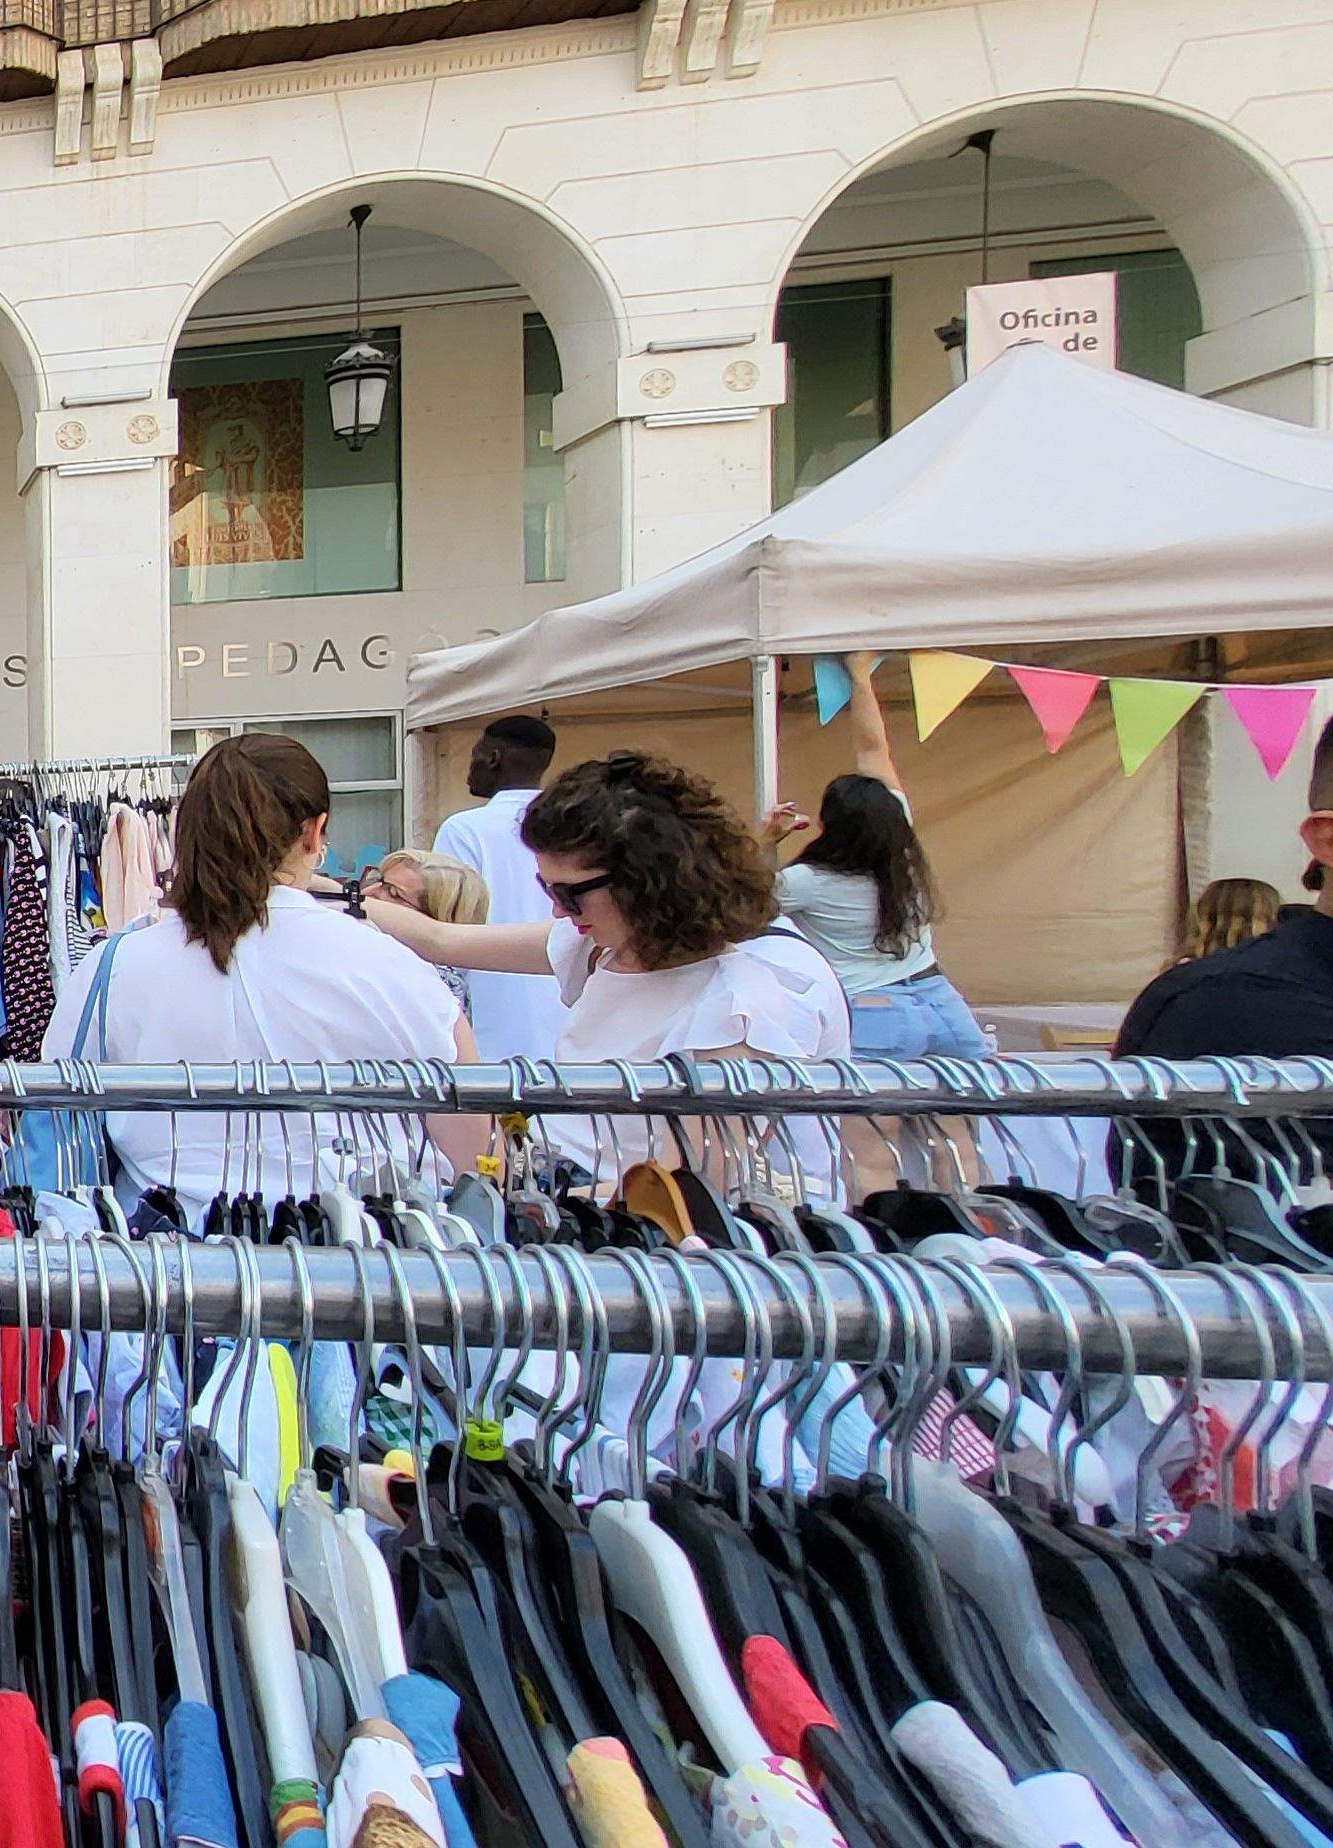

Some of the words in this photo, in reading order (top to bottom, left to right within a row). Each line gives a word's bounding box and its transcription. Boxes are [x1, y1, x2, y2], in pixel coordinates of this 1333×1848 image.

[999, 306, 1098, 331] Oficina
[1063, 332, 1098, 352] de
[176, 624, 501, 681] PEDAG
